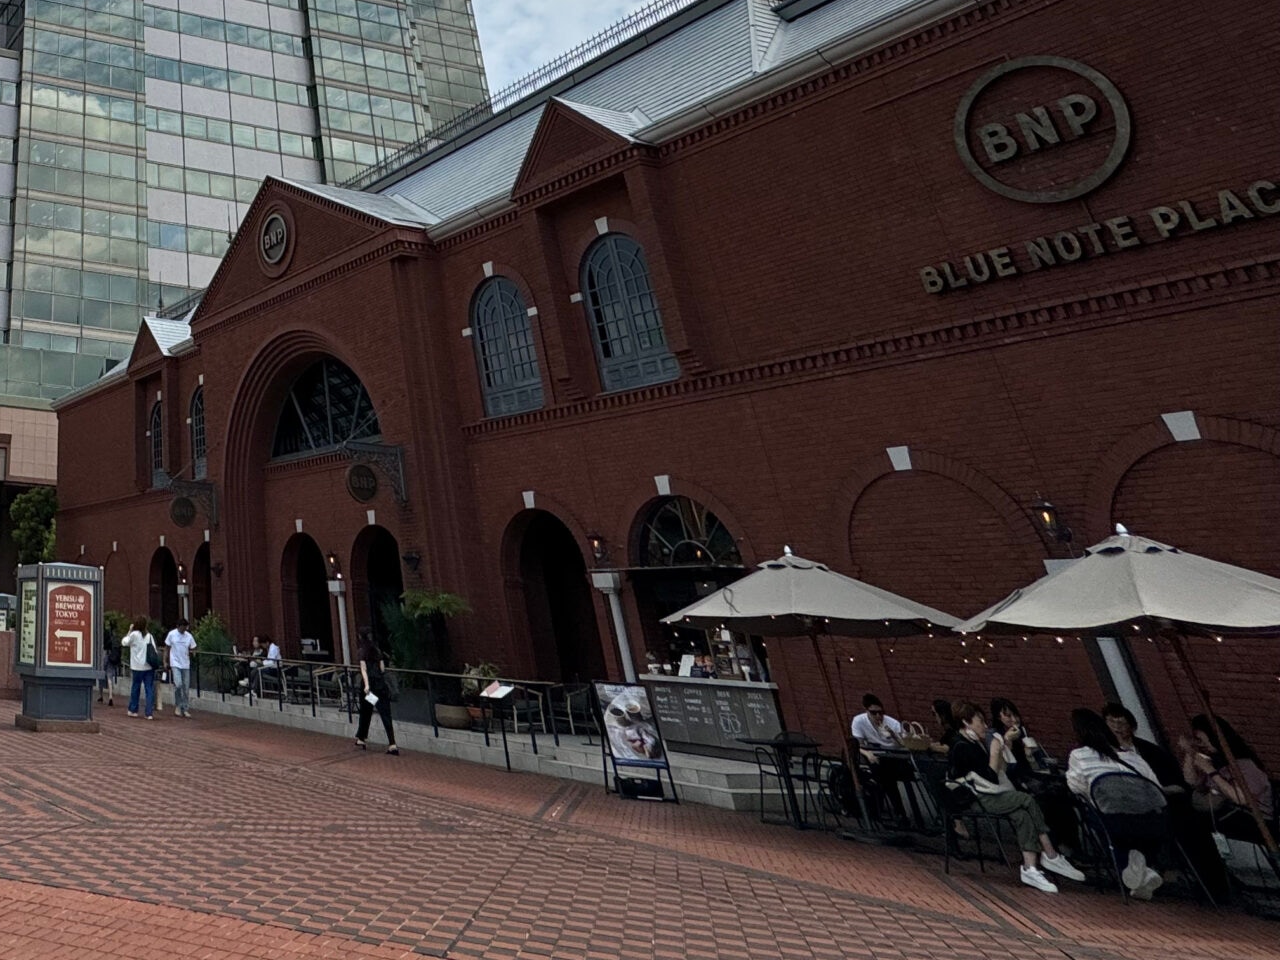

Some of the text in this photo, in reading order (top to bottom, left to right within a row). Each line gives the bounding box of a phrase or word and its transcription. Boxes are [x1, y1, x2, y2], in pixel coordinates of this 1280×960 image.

[975, 93, 1097, 164] BNP
[264, 228, 283, 249] BNP
[920, 246, 1017, 294] BLUE
[1025, 216, 1141, 270] NOTE
[55, 594, 78, 603] YEBISU
[55, 602, 85, 611] BREWERY
[55, 610, 78, 619] TOKYO
